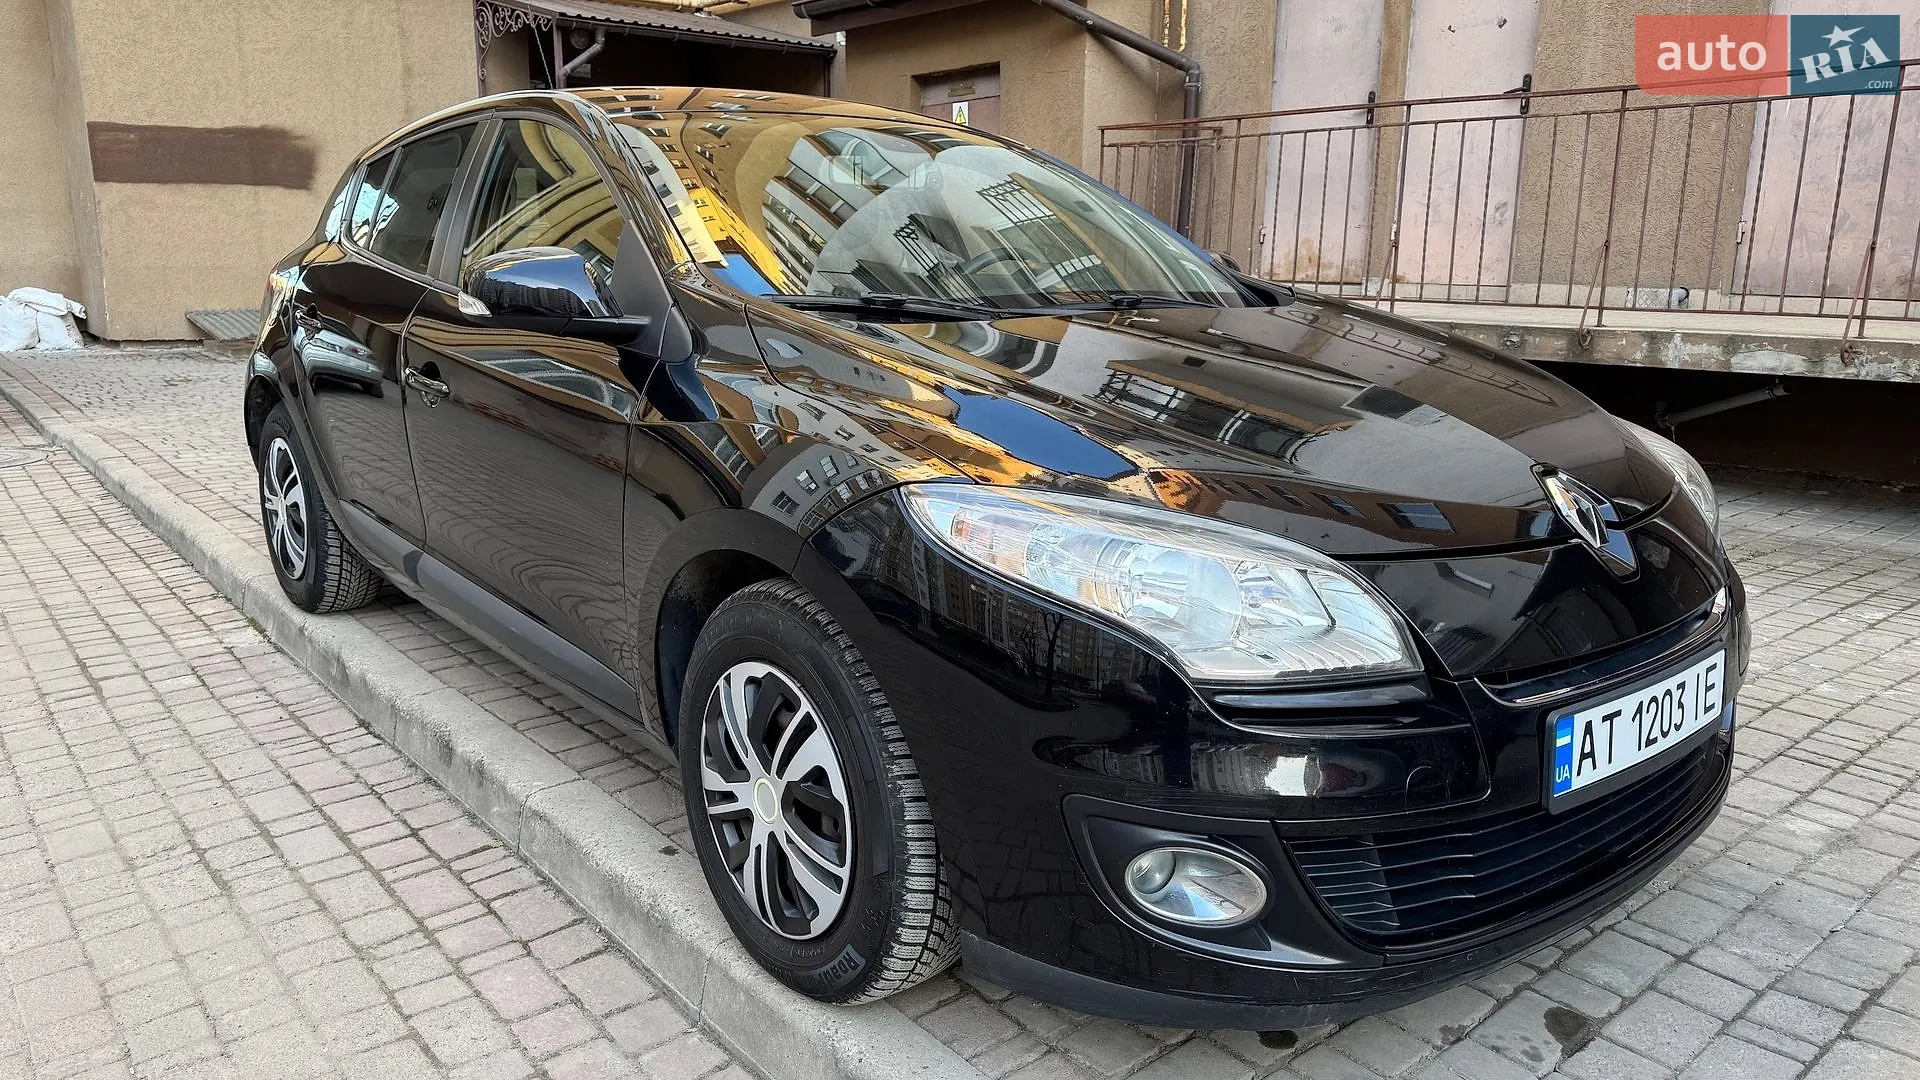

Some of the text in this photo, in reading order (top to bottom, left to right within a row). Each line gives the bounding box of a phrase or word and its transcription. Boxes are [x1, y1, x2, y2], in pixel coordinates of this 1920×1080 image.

[1576, 662, 1718, 777] AT 1203 IE
[1556, 765, 1571, 783] UA
